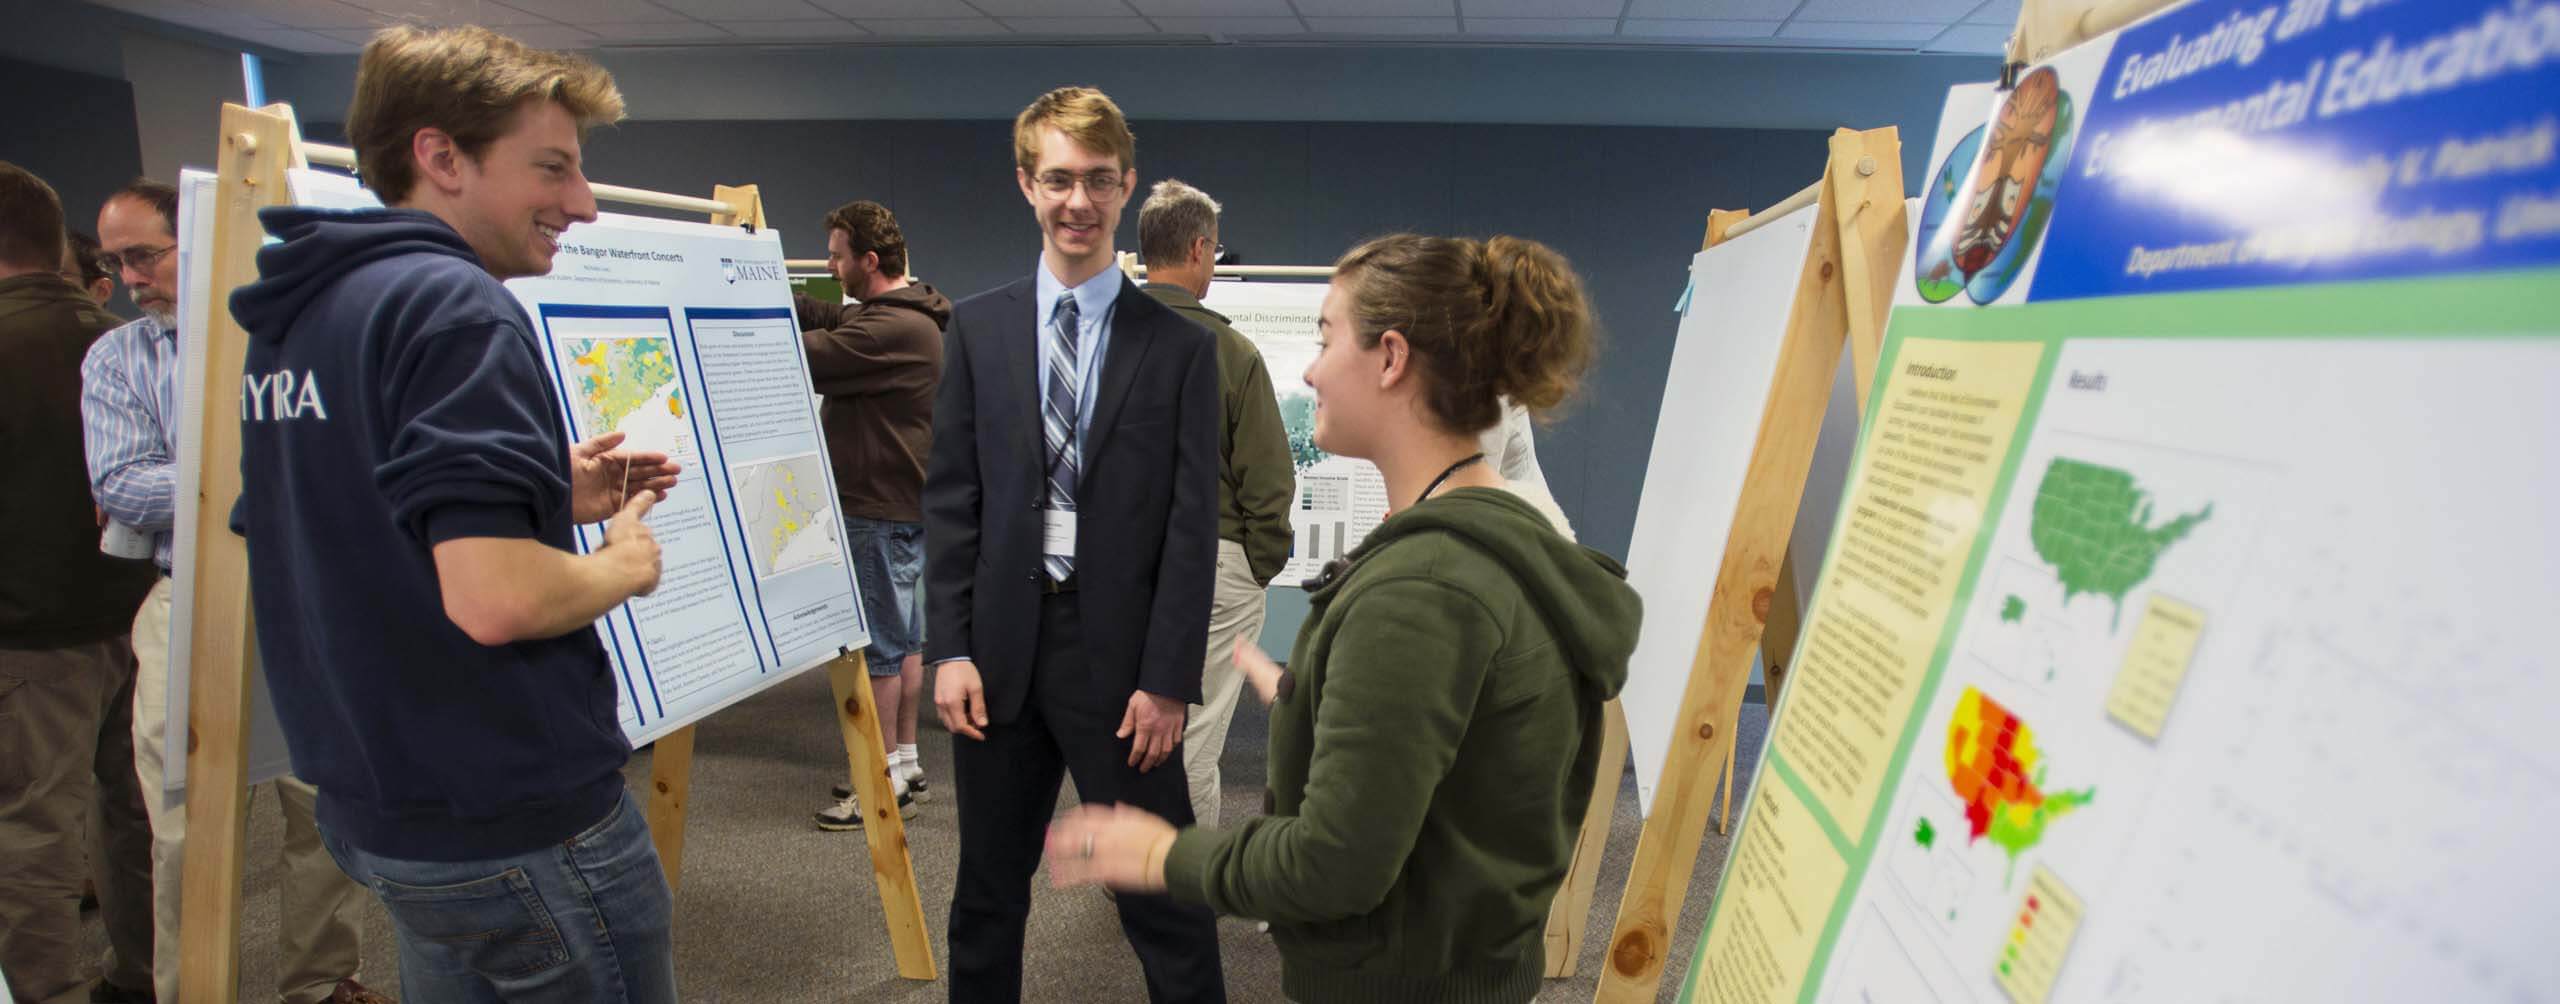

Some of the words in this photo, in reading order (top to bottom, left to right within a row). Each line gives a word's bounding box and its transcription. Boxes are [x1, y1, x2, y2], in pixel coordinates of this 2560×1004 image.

[2113, 6, 2277, 100] Evaluating
[564, 242, 579, 255] the
[580, 245, 607, 259] Bangor
[608, 248, 651, 261] Waterfront
[651, 251, 684, 263] Concerts
[2125, 238, 2236, 277] Department
[736, 265, 781, 281] MAINE
[1905, 362, 1958, 382] Introduction
